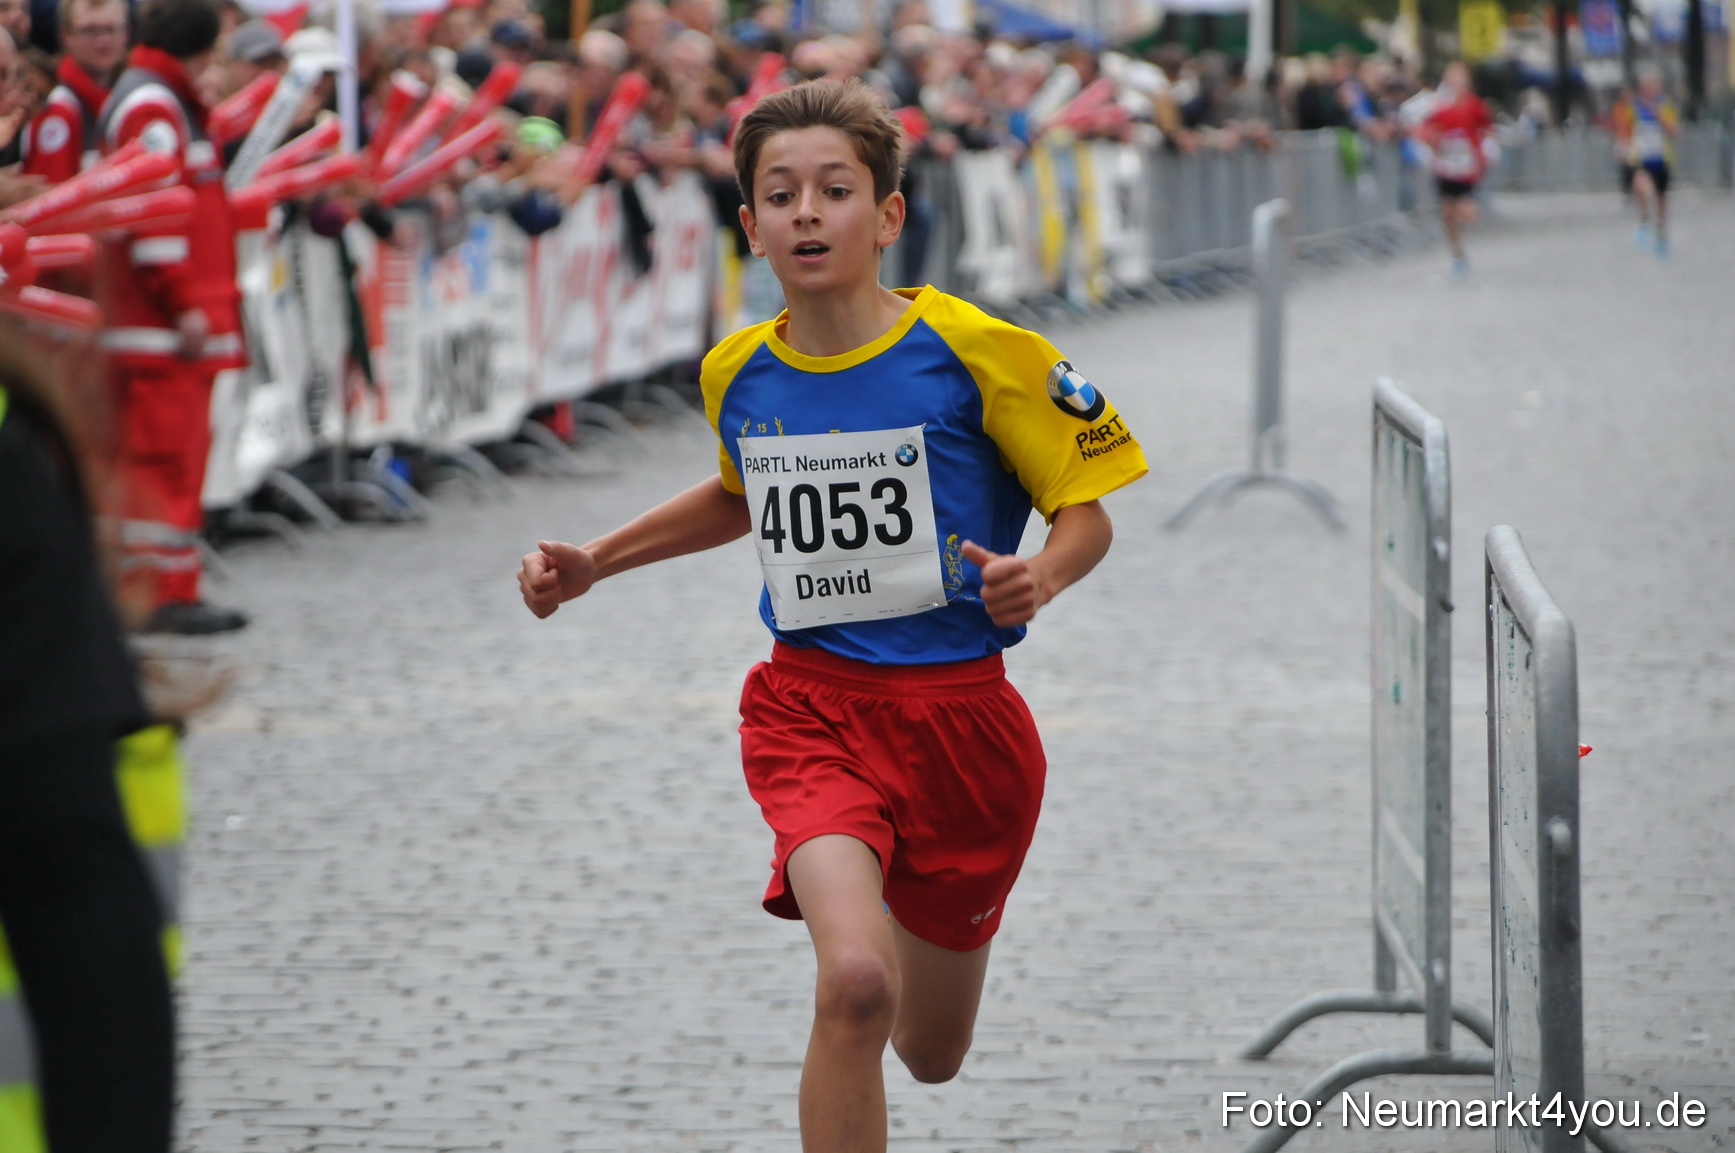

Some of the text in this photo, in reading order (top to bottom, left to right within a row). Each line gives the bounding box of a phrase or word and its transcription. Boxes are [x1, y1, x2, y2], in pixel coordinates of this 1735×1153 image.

[757, 424, 767, 433] 15
[745, 452, 887, 473] PARTL Neumarkt
[761, 478, 913, 554] 4053
[796, 569, 872, 600] David
